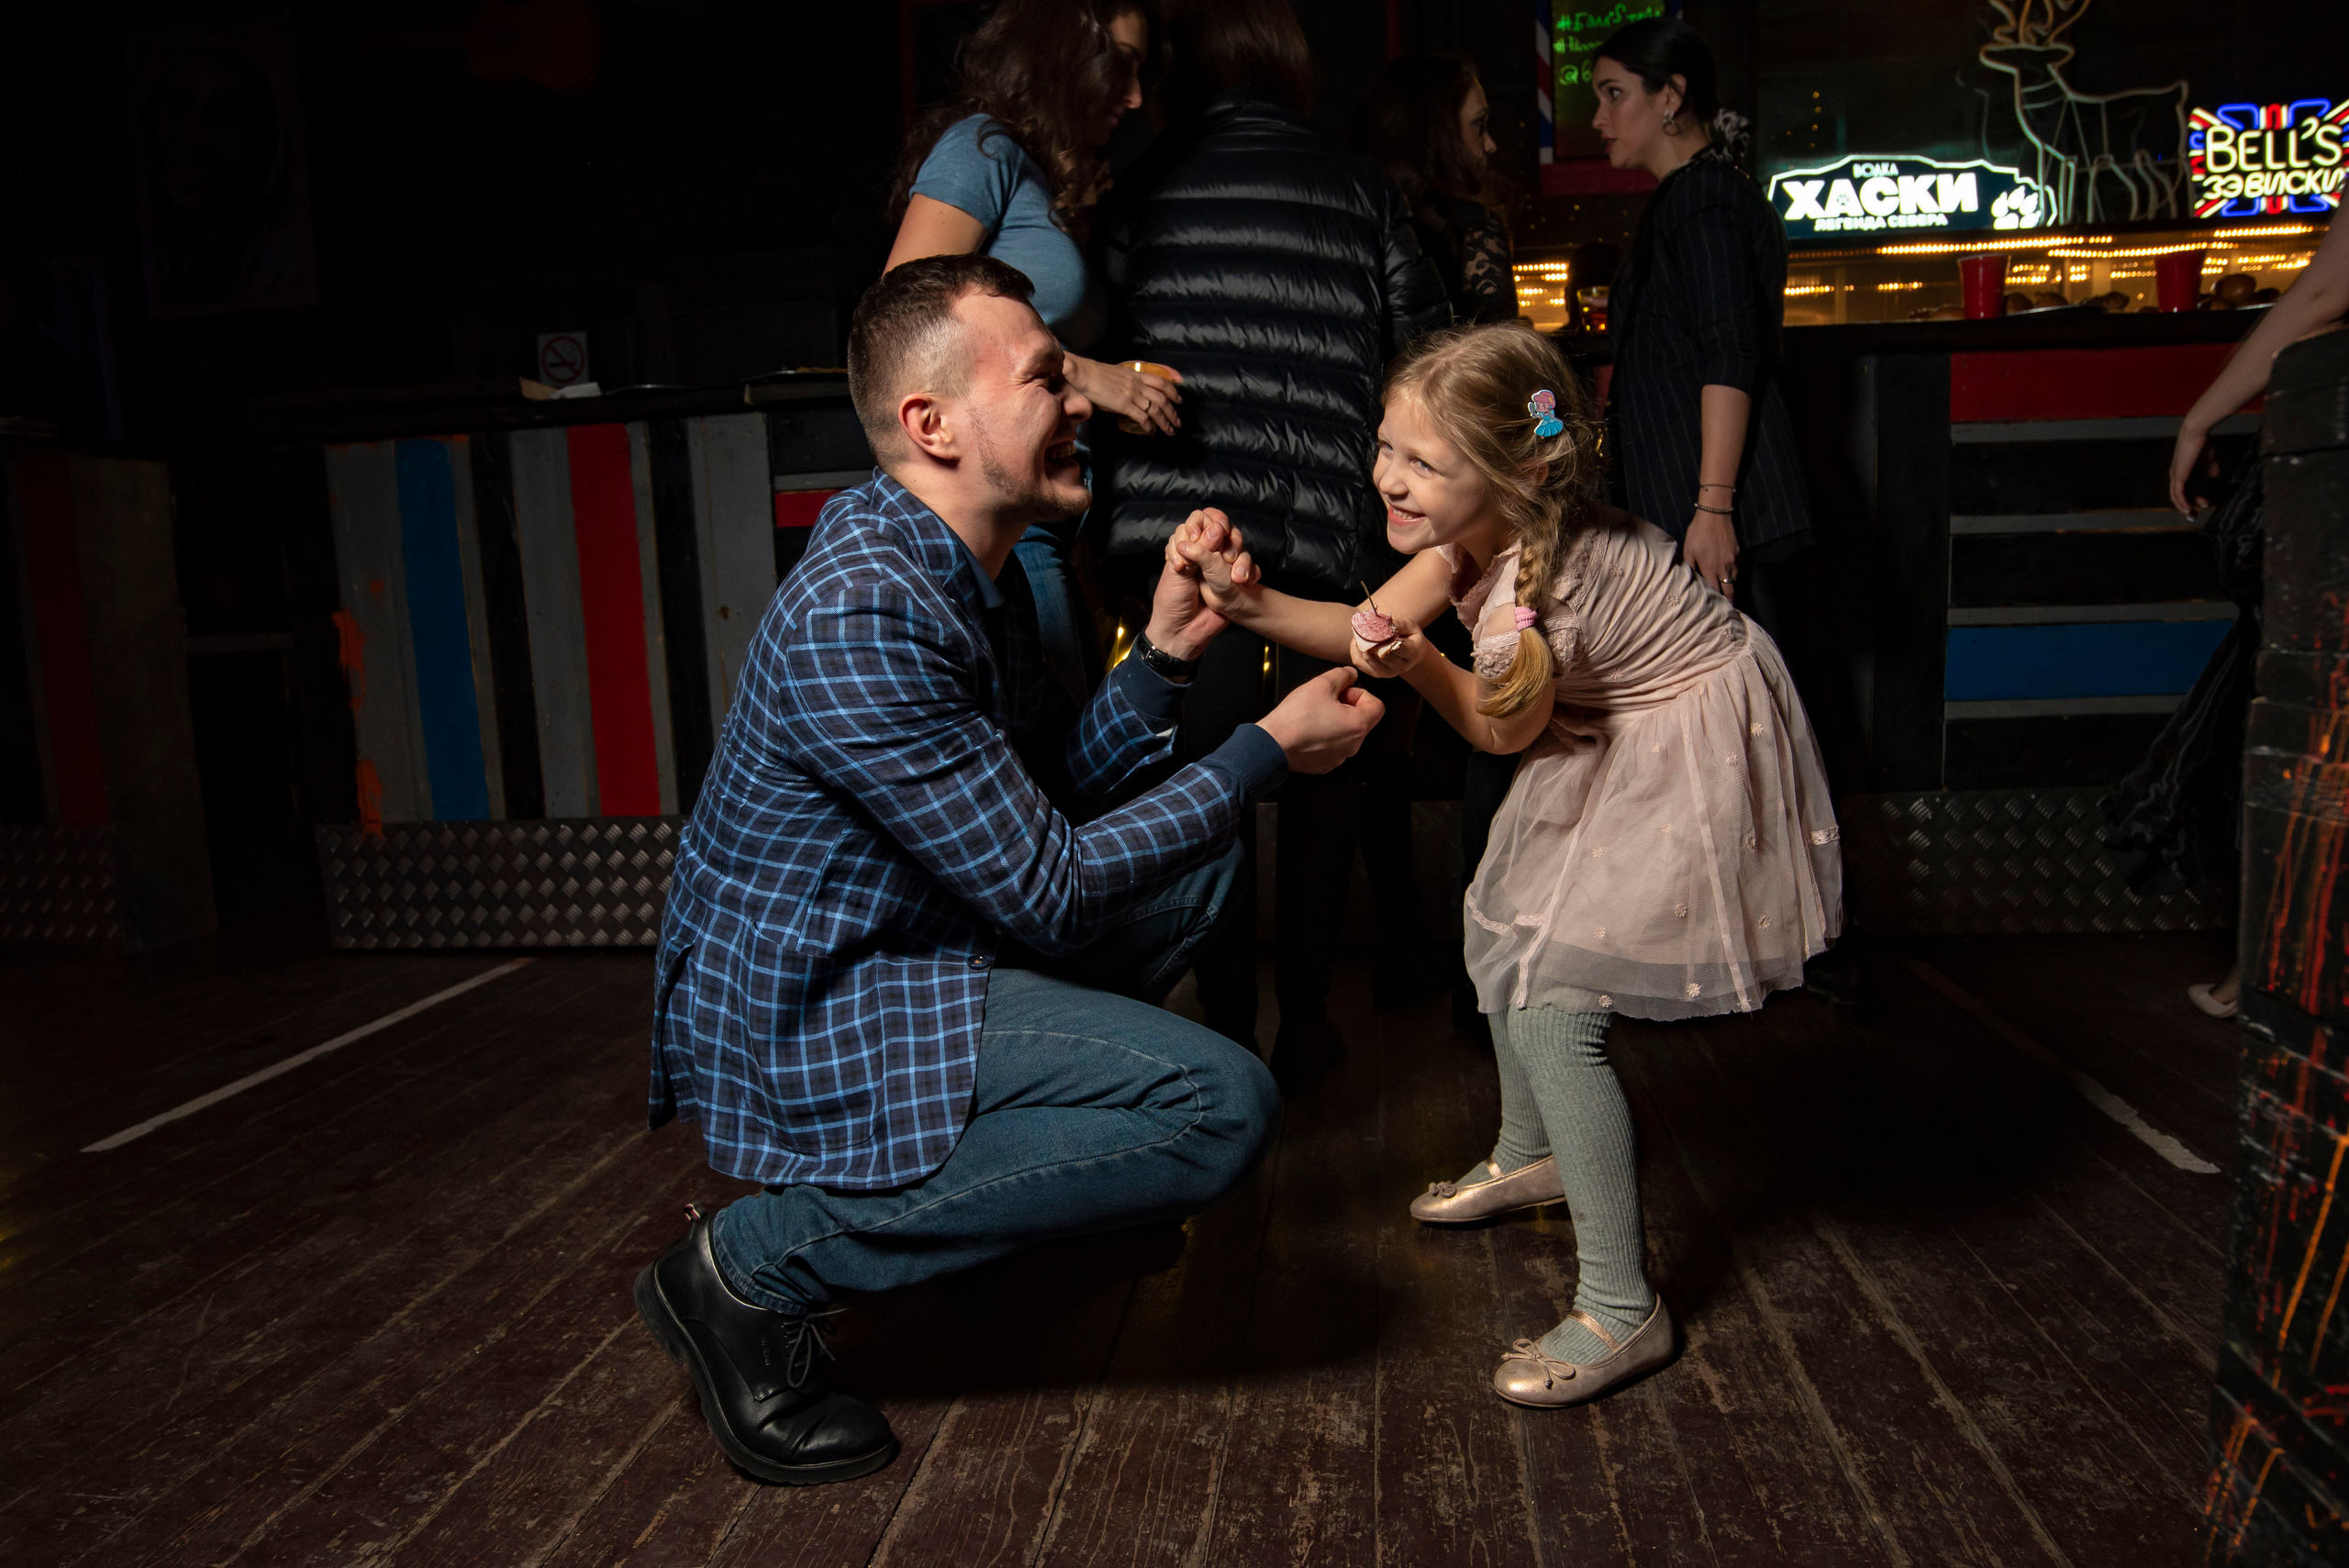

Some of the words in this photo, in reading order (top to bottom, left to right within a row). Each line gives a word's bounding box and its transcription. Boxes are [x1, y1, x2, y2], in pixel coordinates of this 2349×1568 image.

[2206, 116, 2343, 172] BELL'S
[1853, 161, 1898, 179] ВОДКА
[1782, 172, 1978, 220] ХАСКИ
[1814, 216, 1887, 231] ЛЕГЕНДА
[1887, 213, 1949, 228] СЕВЕРА
